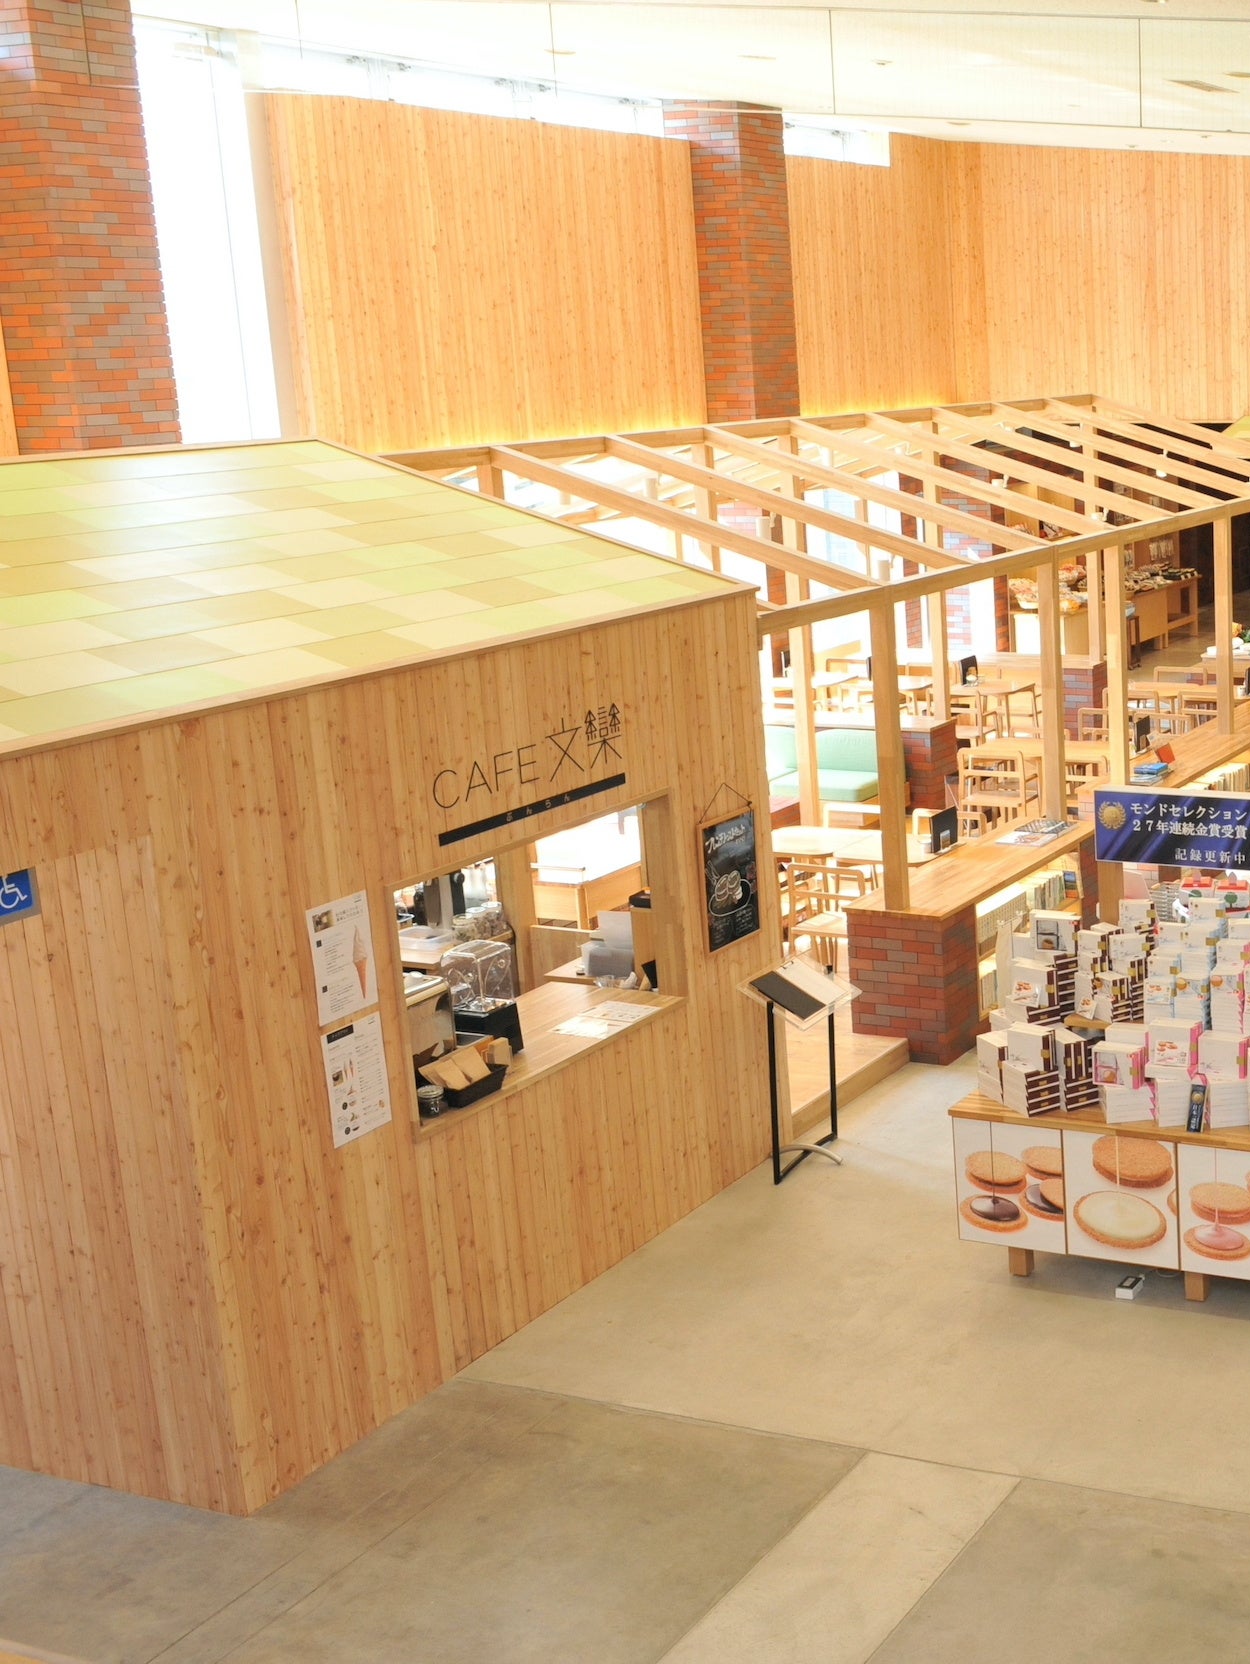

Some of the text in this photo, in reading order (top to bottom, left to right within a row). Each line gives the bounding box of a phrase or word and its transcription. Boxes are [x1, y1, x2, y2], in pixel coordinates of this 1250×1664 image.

[432, 744, 540, 809] CAFE
[1130, 802, 1248, 821] モンドセレクション
